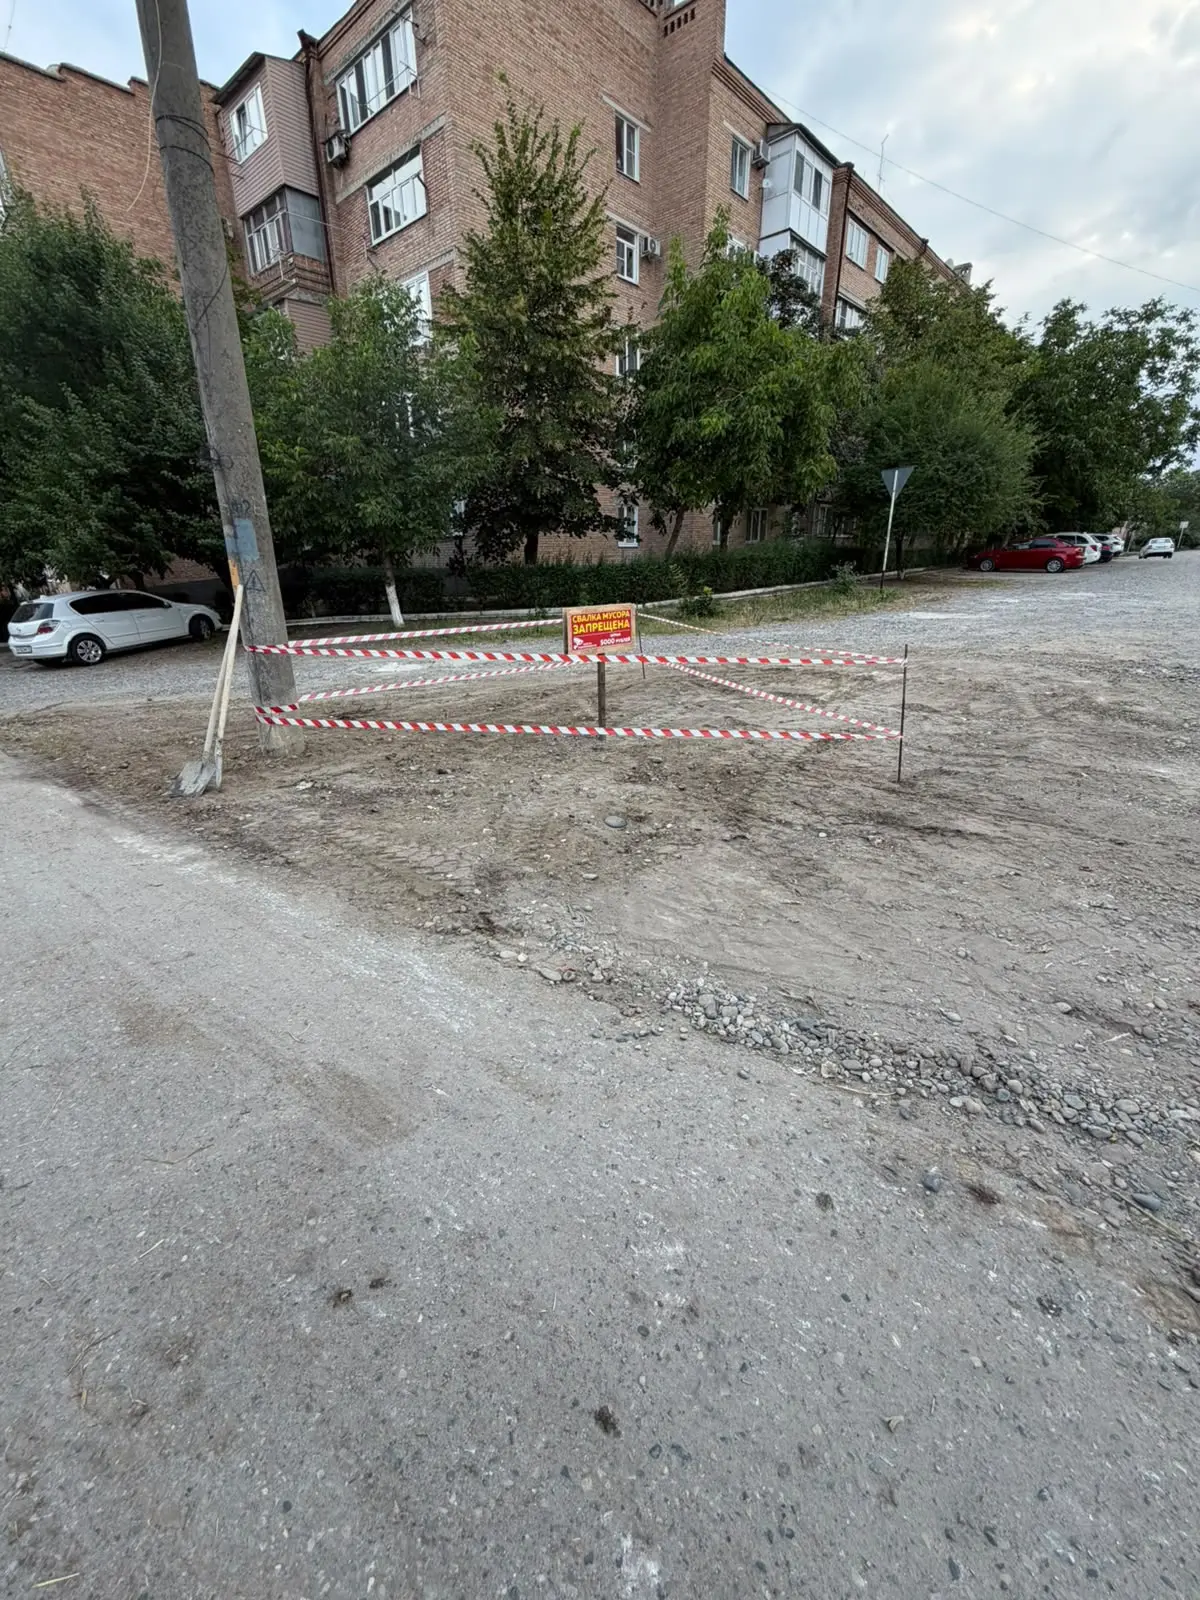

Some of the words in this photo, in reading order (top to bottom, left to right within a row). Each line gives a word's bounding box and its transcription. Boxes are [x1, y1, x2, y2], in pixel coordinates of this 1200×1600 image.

[572, 613, 602, 623] СВАЛКА
[602, 610, 630, 620] МУСОРА
[573, 619, 630, 634] ЗАПРЕЩЕНА
